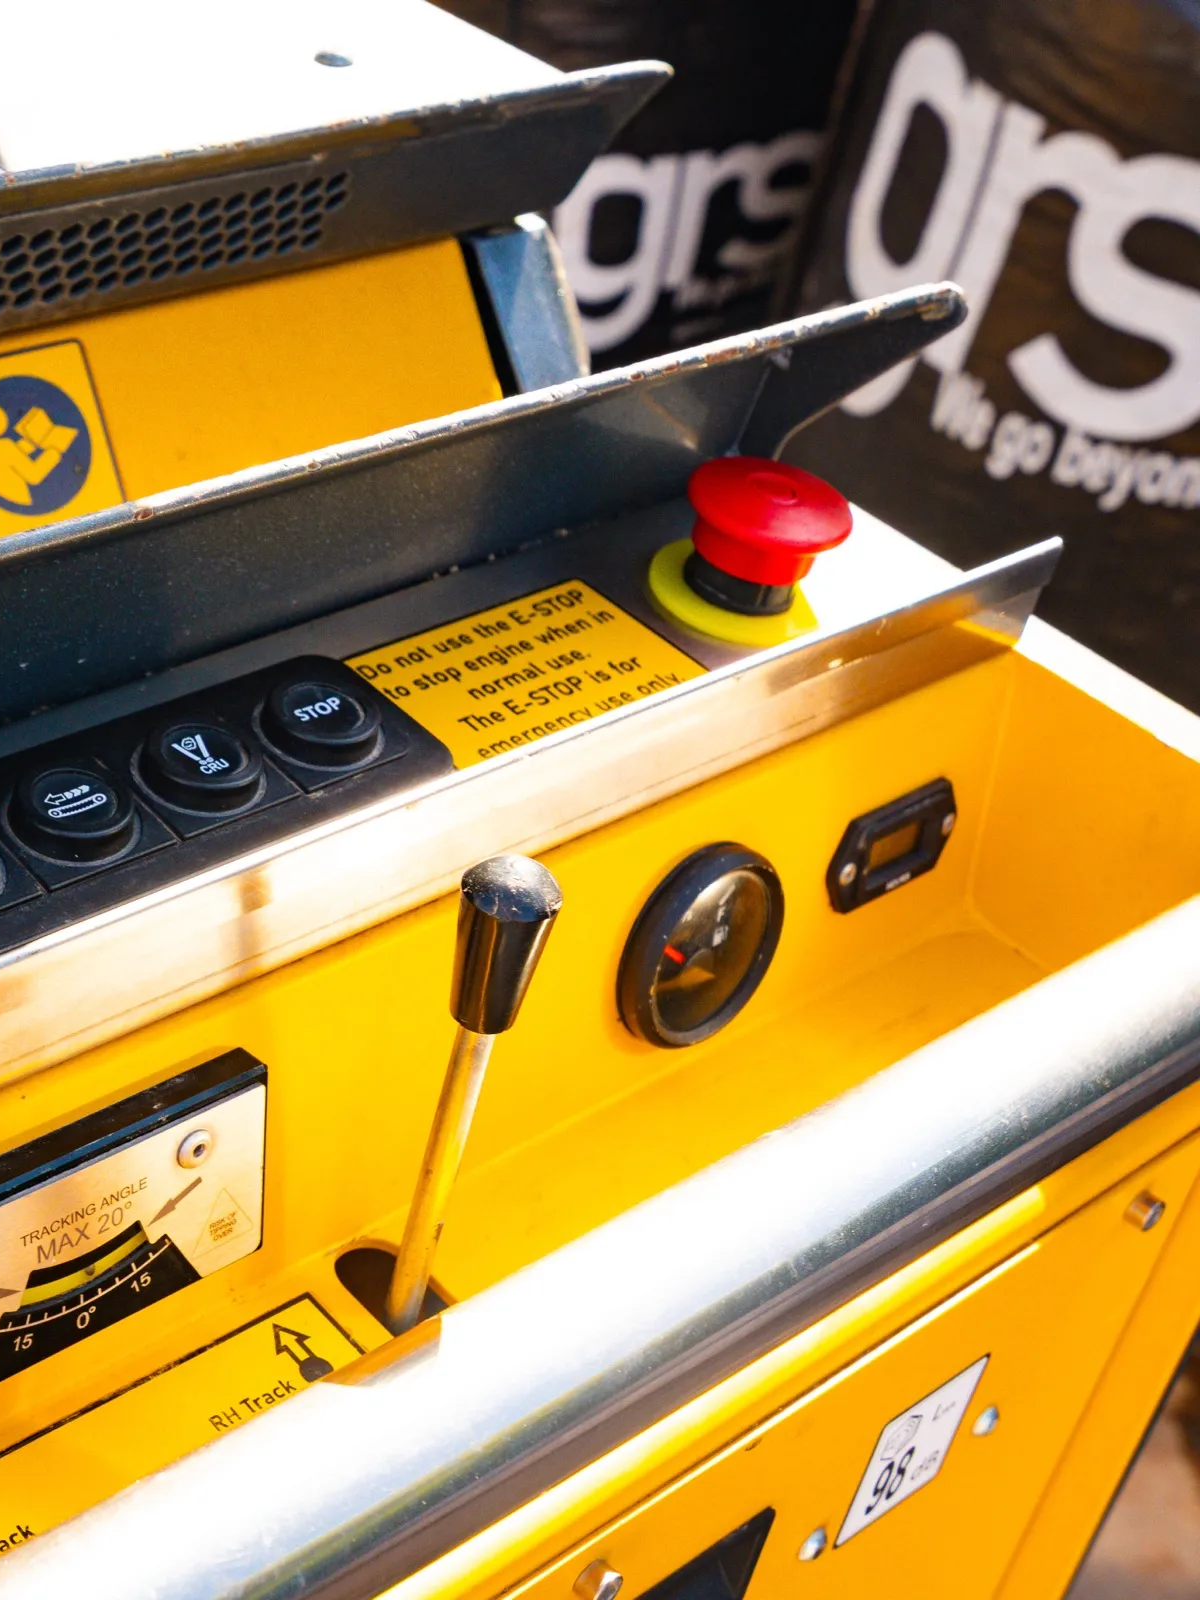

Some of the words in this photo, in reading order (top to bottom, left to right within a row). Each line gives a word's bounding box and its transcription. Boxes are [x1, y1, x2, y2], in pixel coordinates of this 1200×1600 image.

[984, 411, 1055, 481] go
[356, 662, 392, 680] Do
[394, 645, 433, 669] not
[433, 633, 474, 654] use
[472, 617, 511, 638] the
[508, 587, 585, 626] E-STOP
[382, 684, 411, 701] to
[413, 665, 462, 692] stop
[464, 639, 535, 672] engine
[533, 620, 593, 646] when
[587, 608, 615, 625] in
[457, 708, 506, 732] The
[503, 674, 584, 716] E-STOP
[584, 670, 612, 686] is
[610, 654, 642, 680] for
[467, 661, 547, 700] normal
[545, 648, 592, 671] use.
[594, 690, 635, 713] use
[636, 672, 686, 696] only.
[293, 696, 341, 721] STOP
[200, 758, 230, 774] CRU
[19, 1203, 96, 1247] TRACKING
[100, 1176, 148, 1210] ANGLE
[37, 1222, 91, 1264] MAX
[97, 1201, 133, 1235] 20°
[130, 1271, 151, 1293] 15
[13, 1333, 34, 1351] 15
[76, 1305, 97, 1329] 0°
[208, 1406, 242, 1432] RH
[239, 1380, 297, 1413] Track
[864, 1446, 916, 1515] 98
